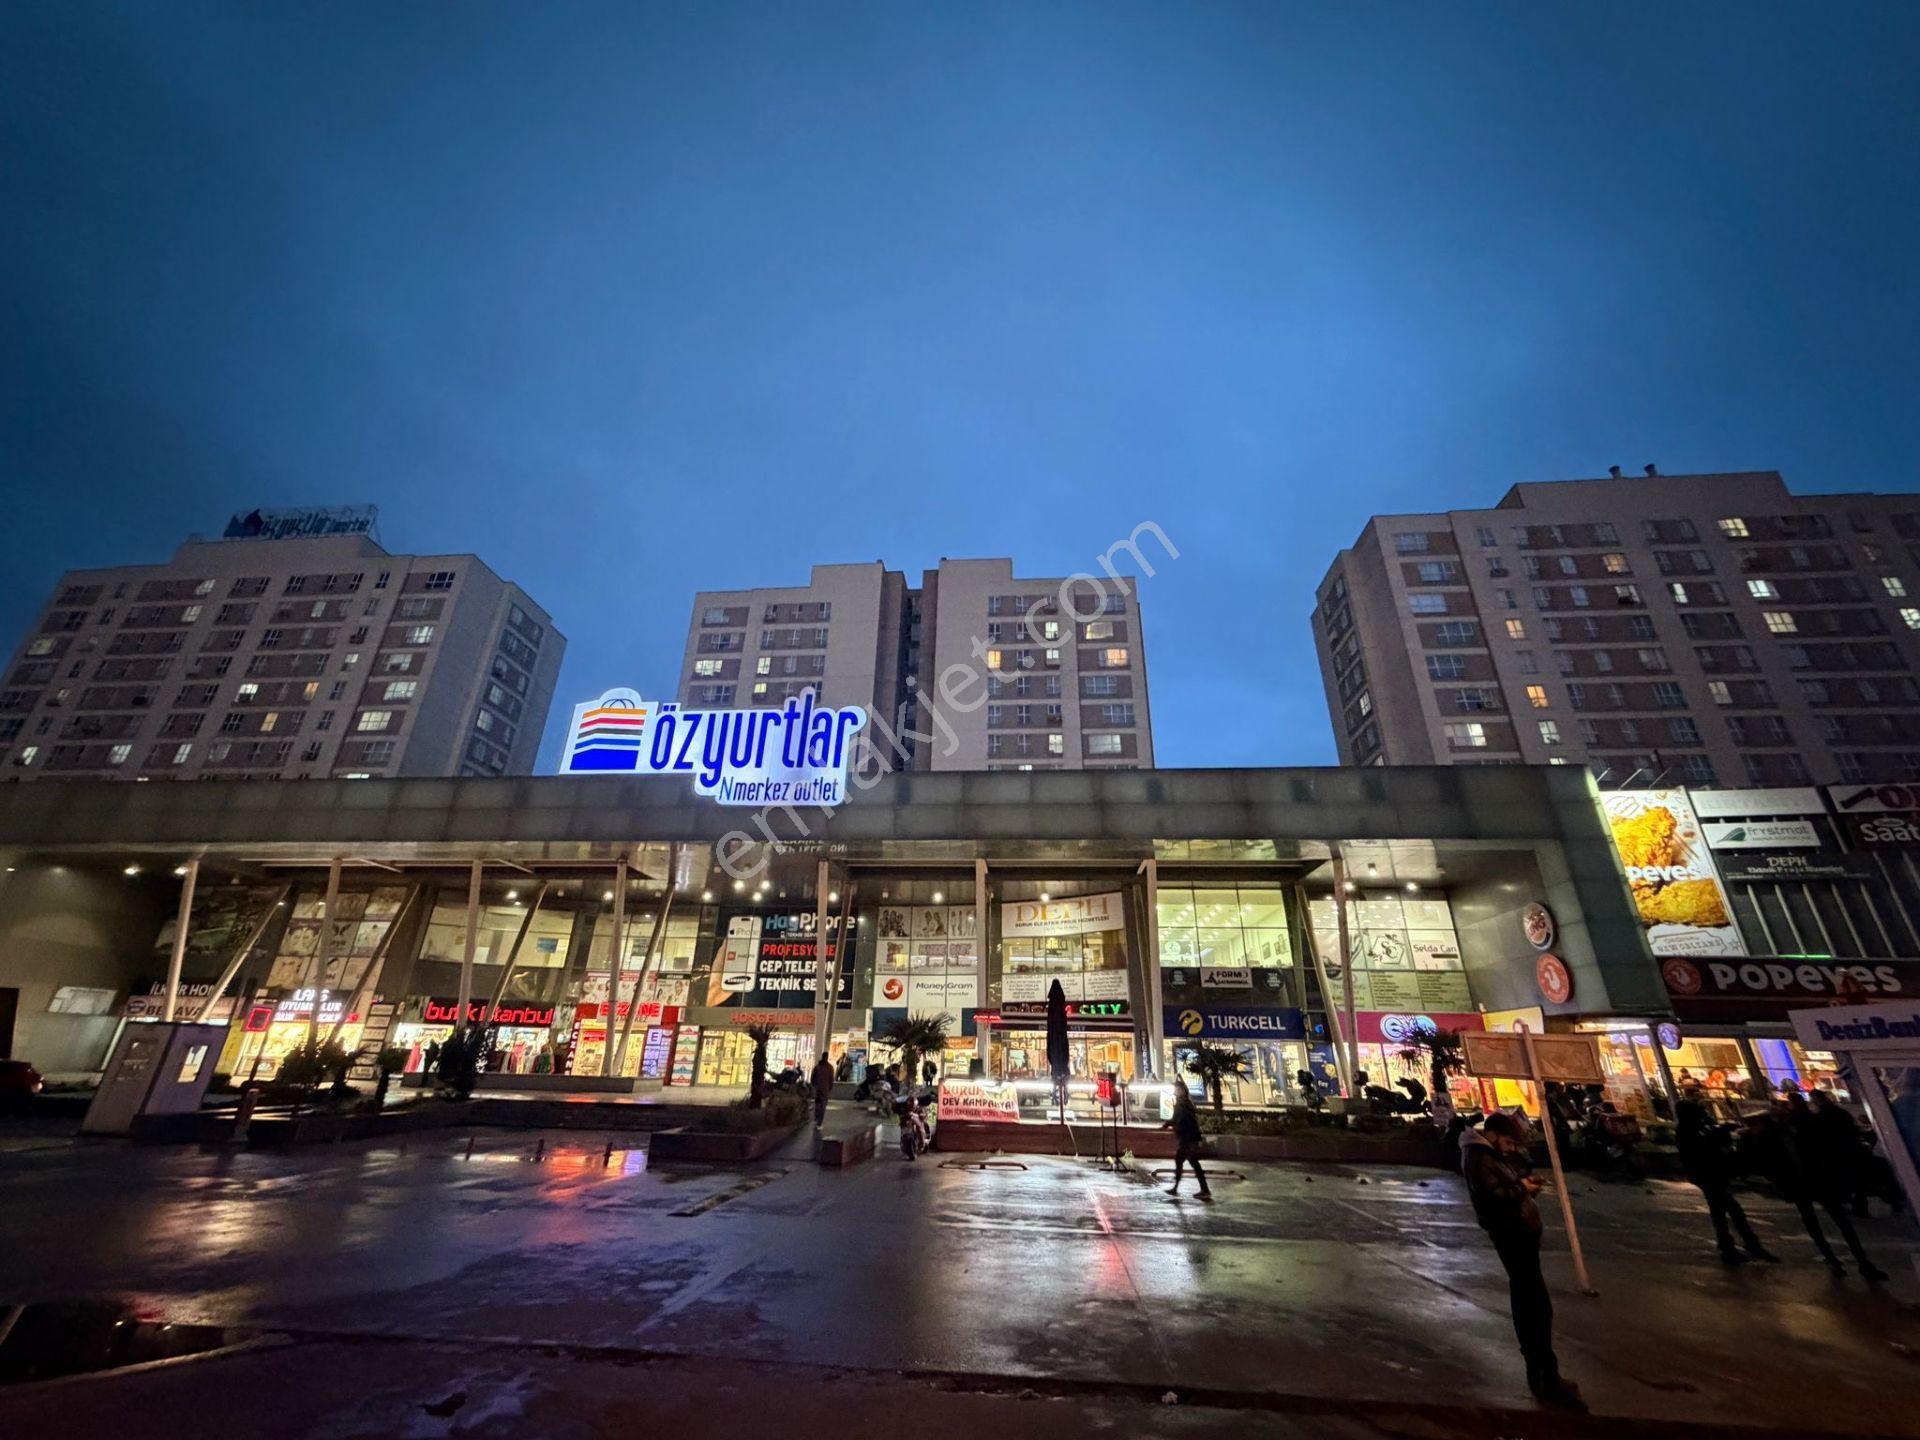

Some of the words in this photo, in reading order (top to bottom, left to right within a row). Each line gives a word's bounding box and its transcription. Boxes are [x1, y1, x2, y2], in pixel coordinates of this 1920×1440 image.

[649, 694, 859, 788] özyurtlar
[794, 777, 838, 802] outlet
[1440, 944, 1457, 953] Can
[760, 960, 783, 973] CEP
[759, 975, 801, 991] TEKNİK
[802, 978, 845, 991] SEVS
[600, 1002, 661, 1018] EZNE
[1208, 1014, 1286, 1031] TURKCELL
[942, 1097, 960, 1106] DEV
